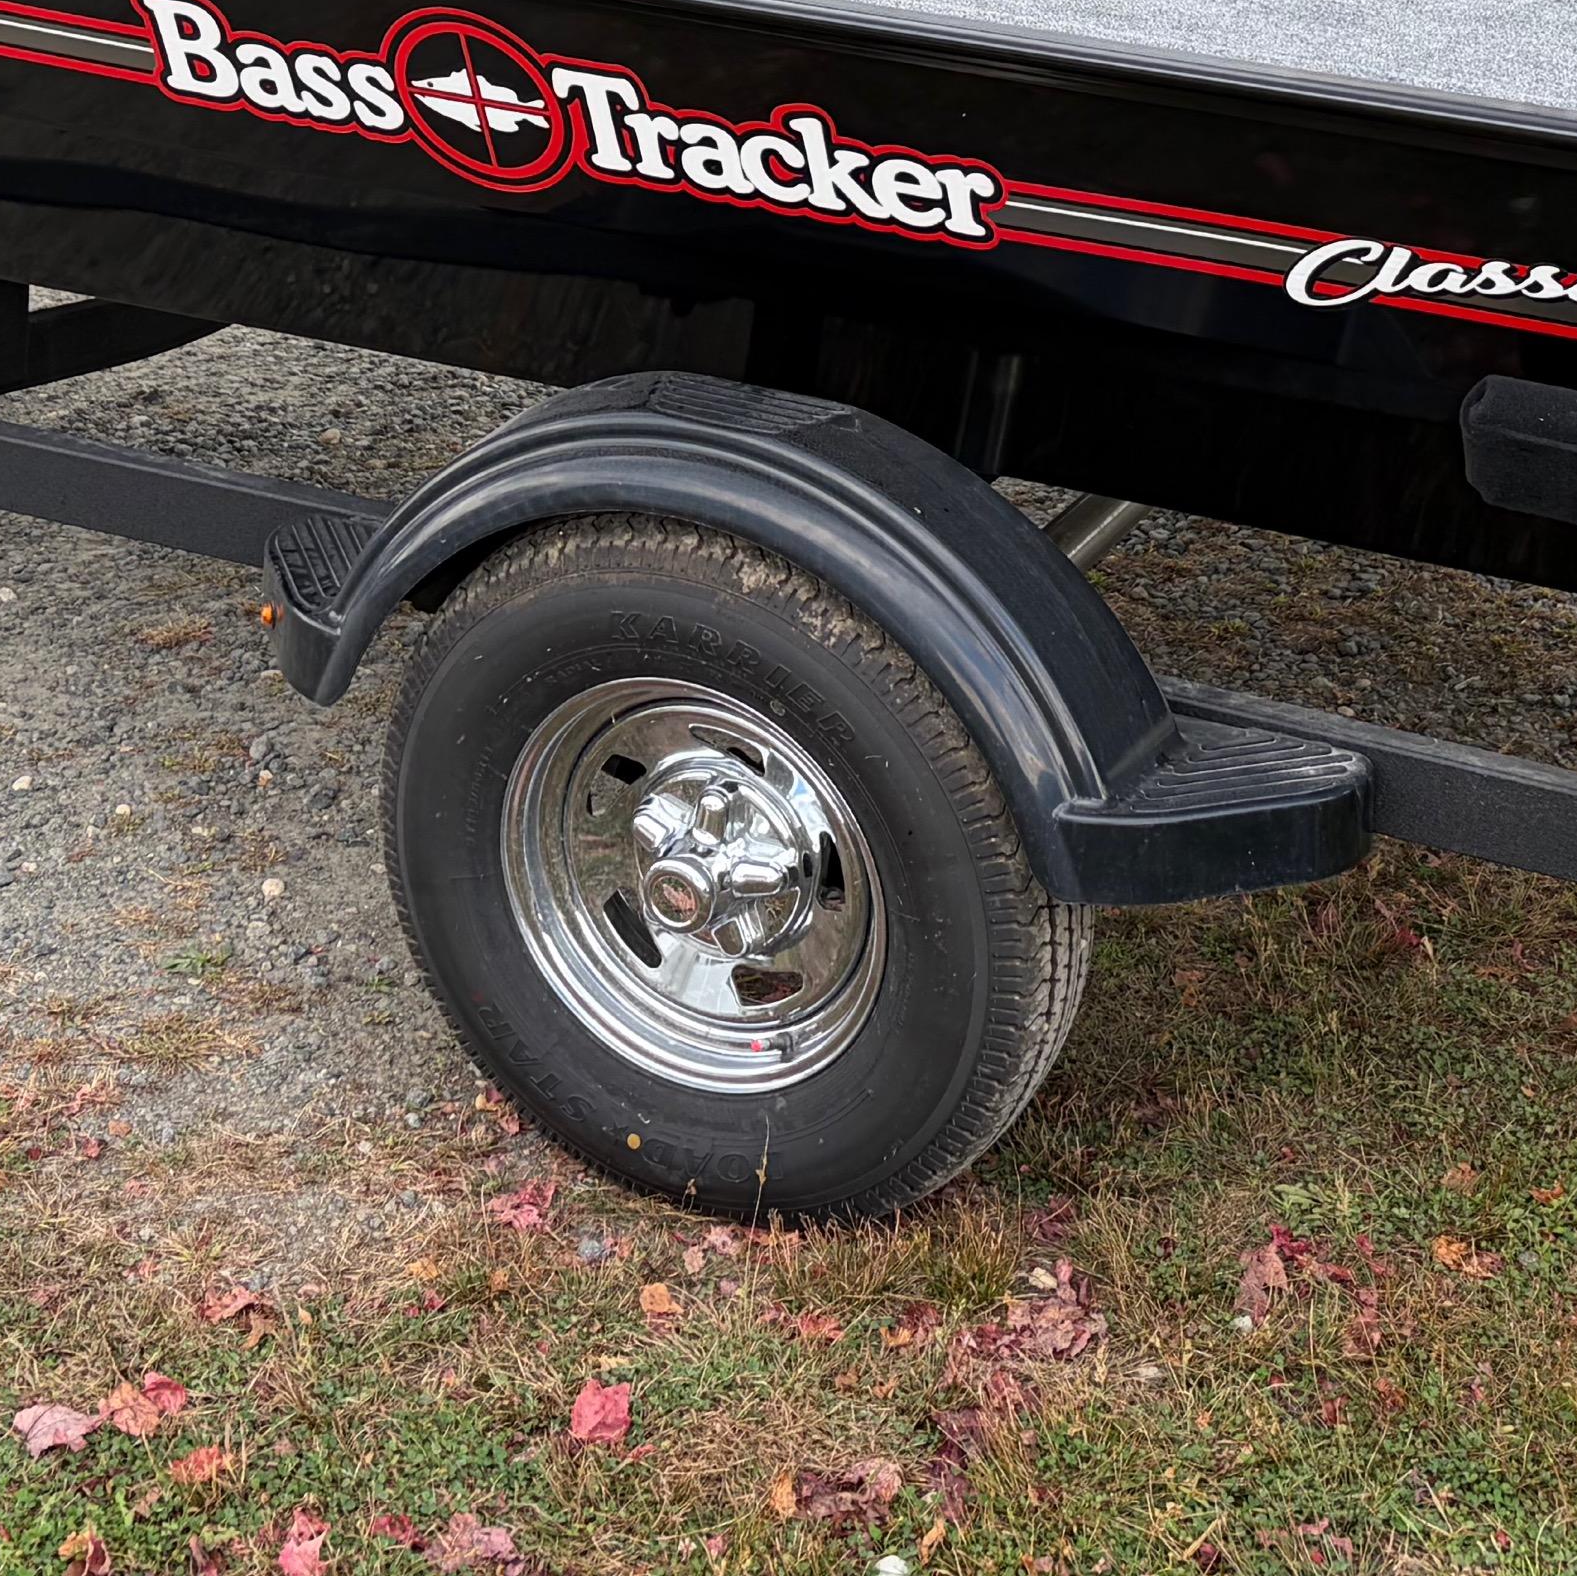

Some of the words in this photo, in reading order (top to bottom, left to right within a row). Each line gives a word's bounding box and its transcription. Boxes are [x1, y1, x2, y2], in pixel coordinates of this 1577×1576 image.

[551, 68, 996, 238] Tracker
[607, 609, 859, 750] KARRIER
[476, 1005, 598, 1123] STAR
